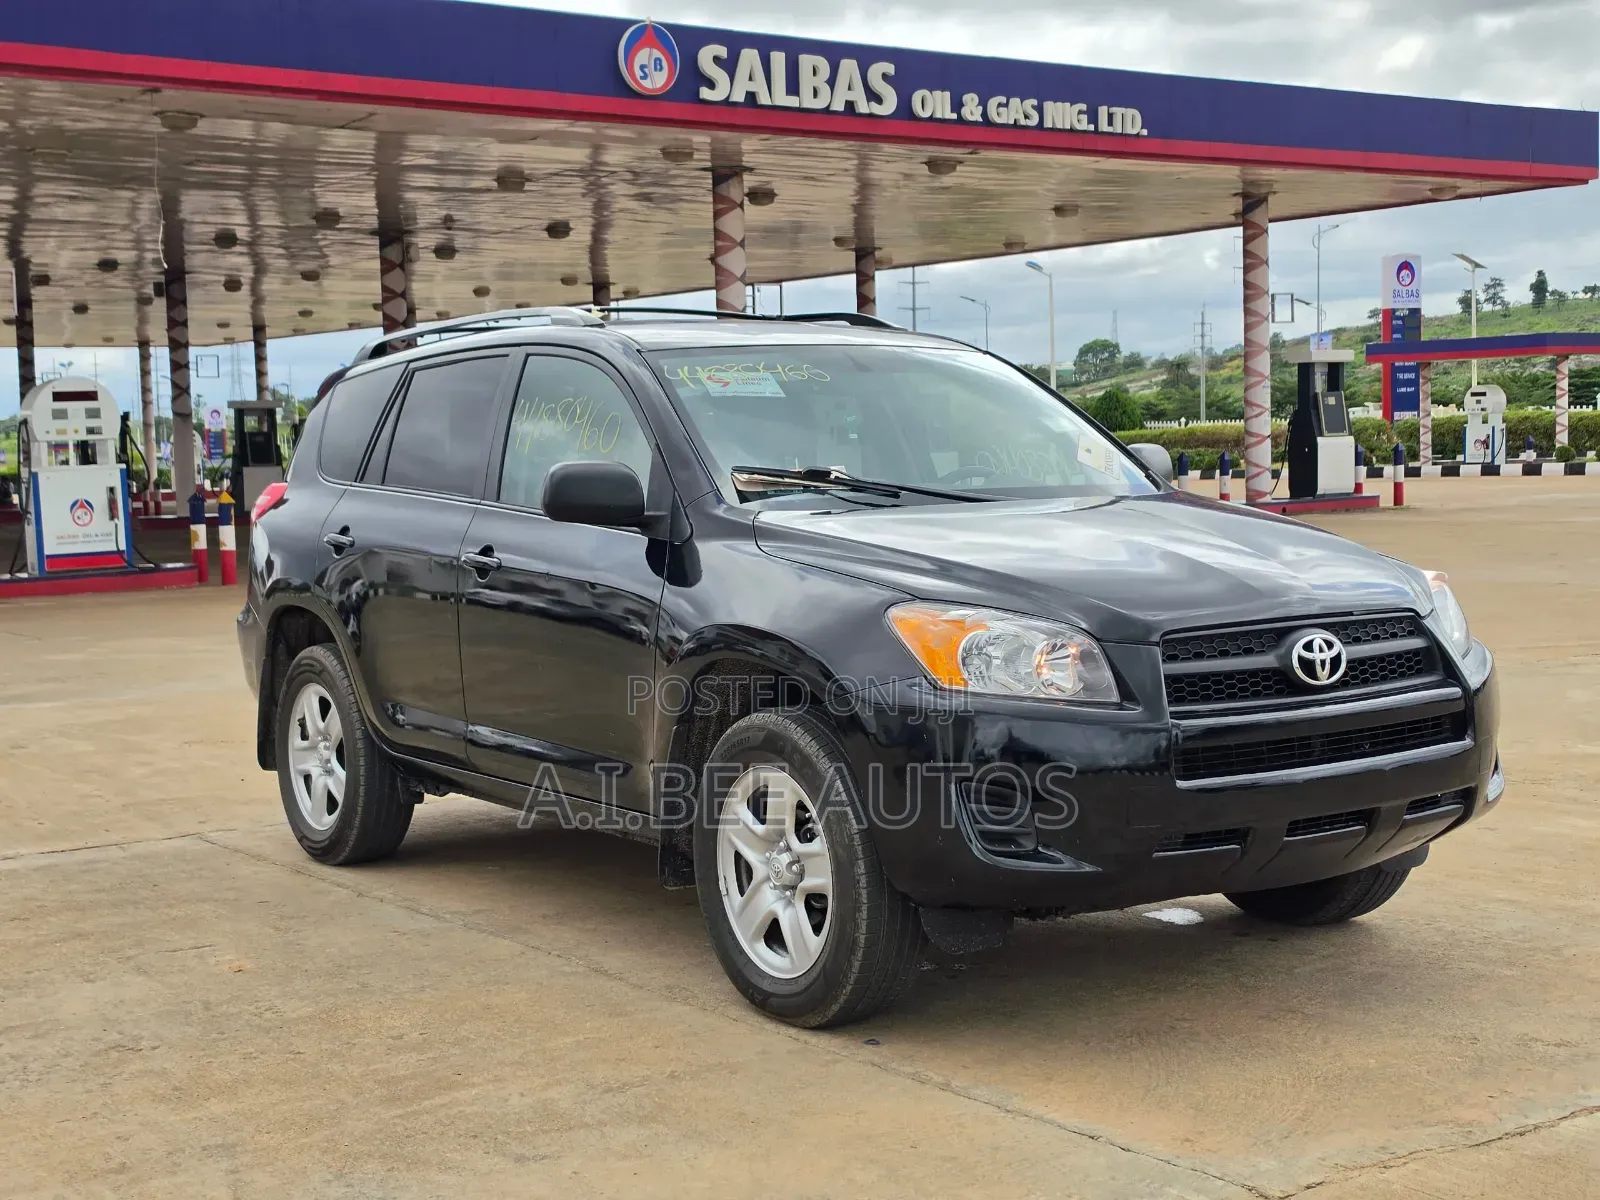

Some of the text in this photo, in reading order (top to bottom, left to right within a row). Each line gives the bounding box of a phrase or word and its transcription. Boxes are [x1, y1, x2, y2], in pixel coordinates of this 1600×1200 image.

[697, 44, 1148, 136] SALBAS OIL & GAS NIG. LTD.
[1392, 288, 1420, 299] SALBAS
